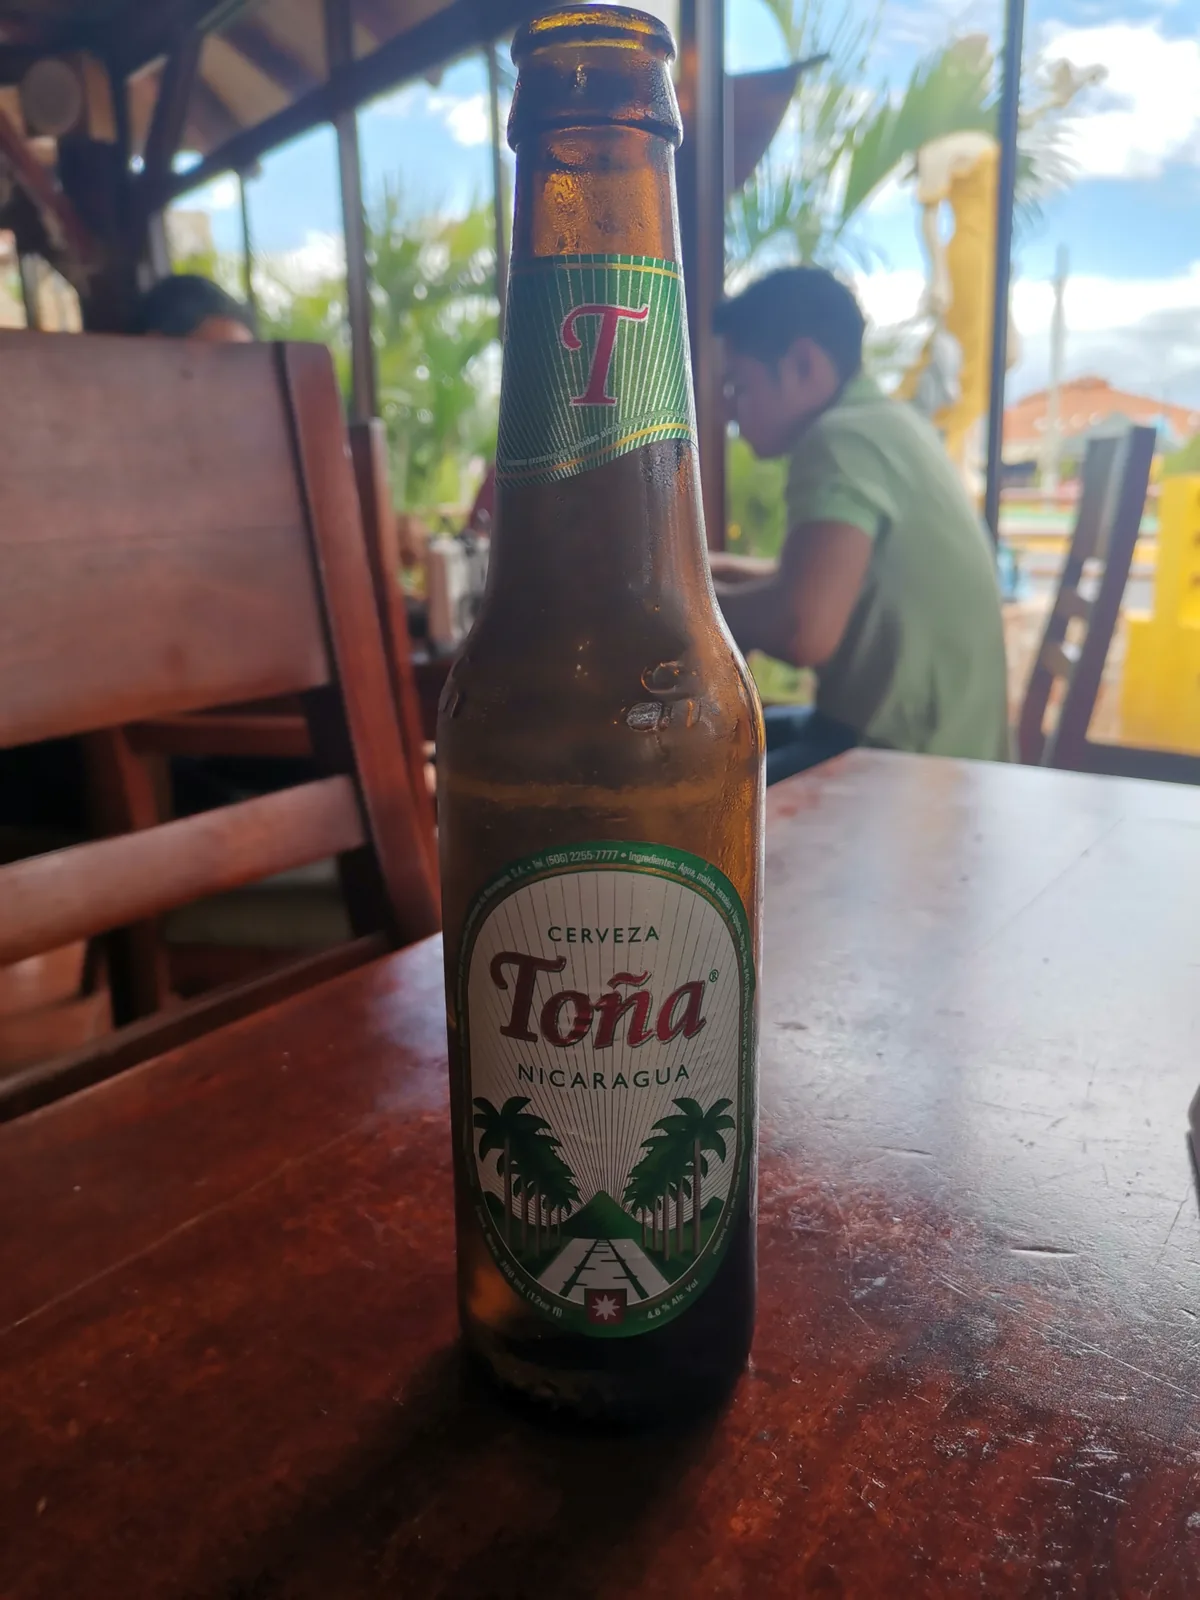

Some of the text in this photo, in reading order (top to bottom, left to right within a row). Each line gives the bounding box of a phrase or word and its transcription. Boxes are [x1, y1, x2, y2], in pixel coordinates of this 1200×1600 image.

[561, 303, 649, 407] T
[545, 853, 568, 867] (505)
[569, 849, 618, 862] 2255-7777
[628, 850, 677, 870] Ingredientes:
[678, 862, 696, 879] Agua,
[547, 926, 660, 943] CERVEZA
[489, 951, 707, 1050] Toña
[518, 1063, 690, 1090] NICARAGUA
